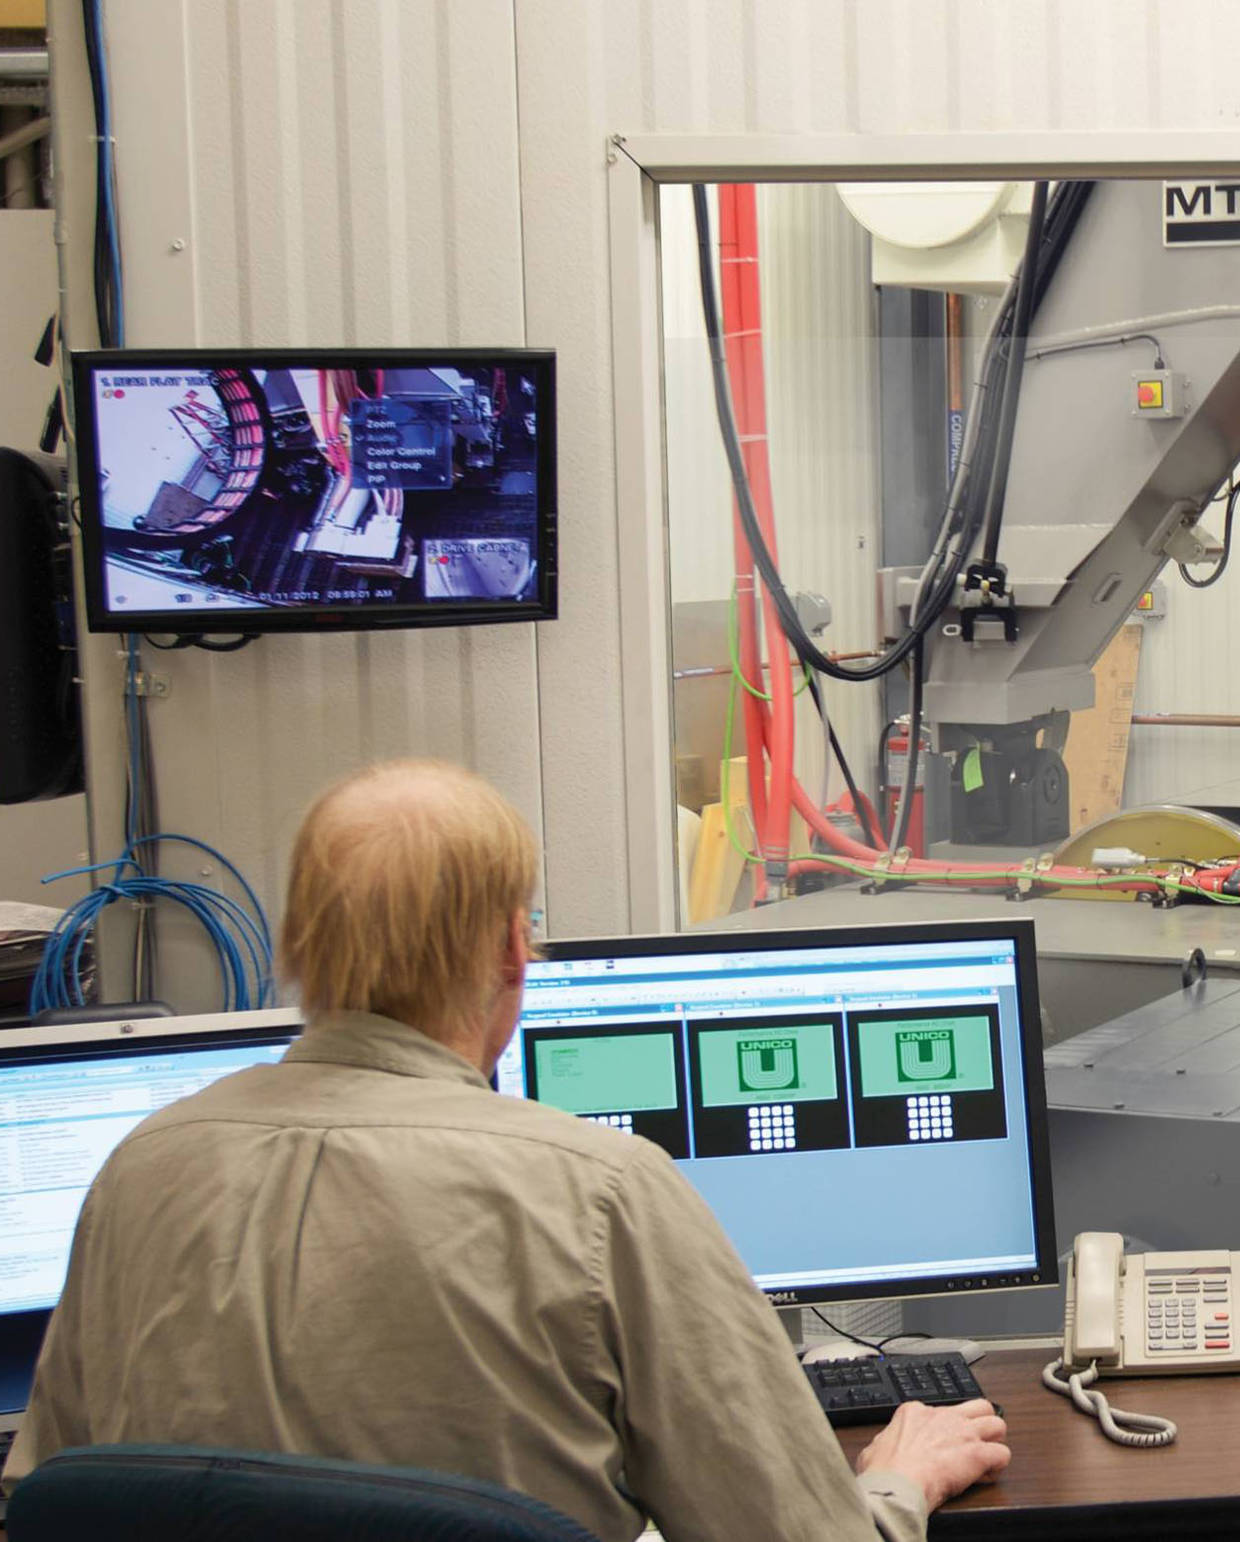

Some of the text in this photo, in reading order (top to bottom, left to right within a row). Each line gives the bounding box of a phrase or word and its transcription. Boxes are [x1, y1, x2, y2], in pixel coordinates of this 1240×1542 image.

[367, 420, 396, 428] Zoom
[367, 446, 436, 455] Color Control
[389, 461, 421, 472] Group
[900, 1031, 950, 1041] UNICO
[741, 1040, 793, 1050] UNICO
